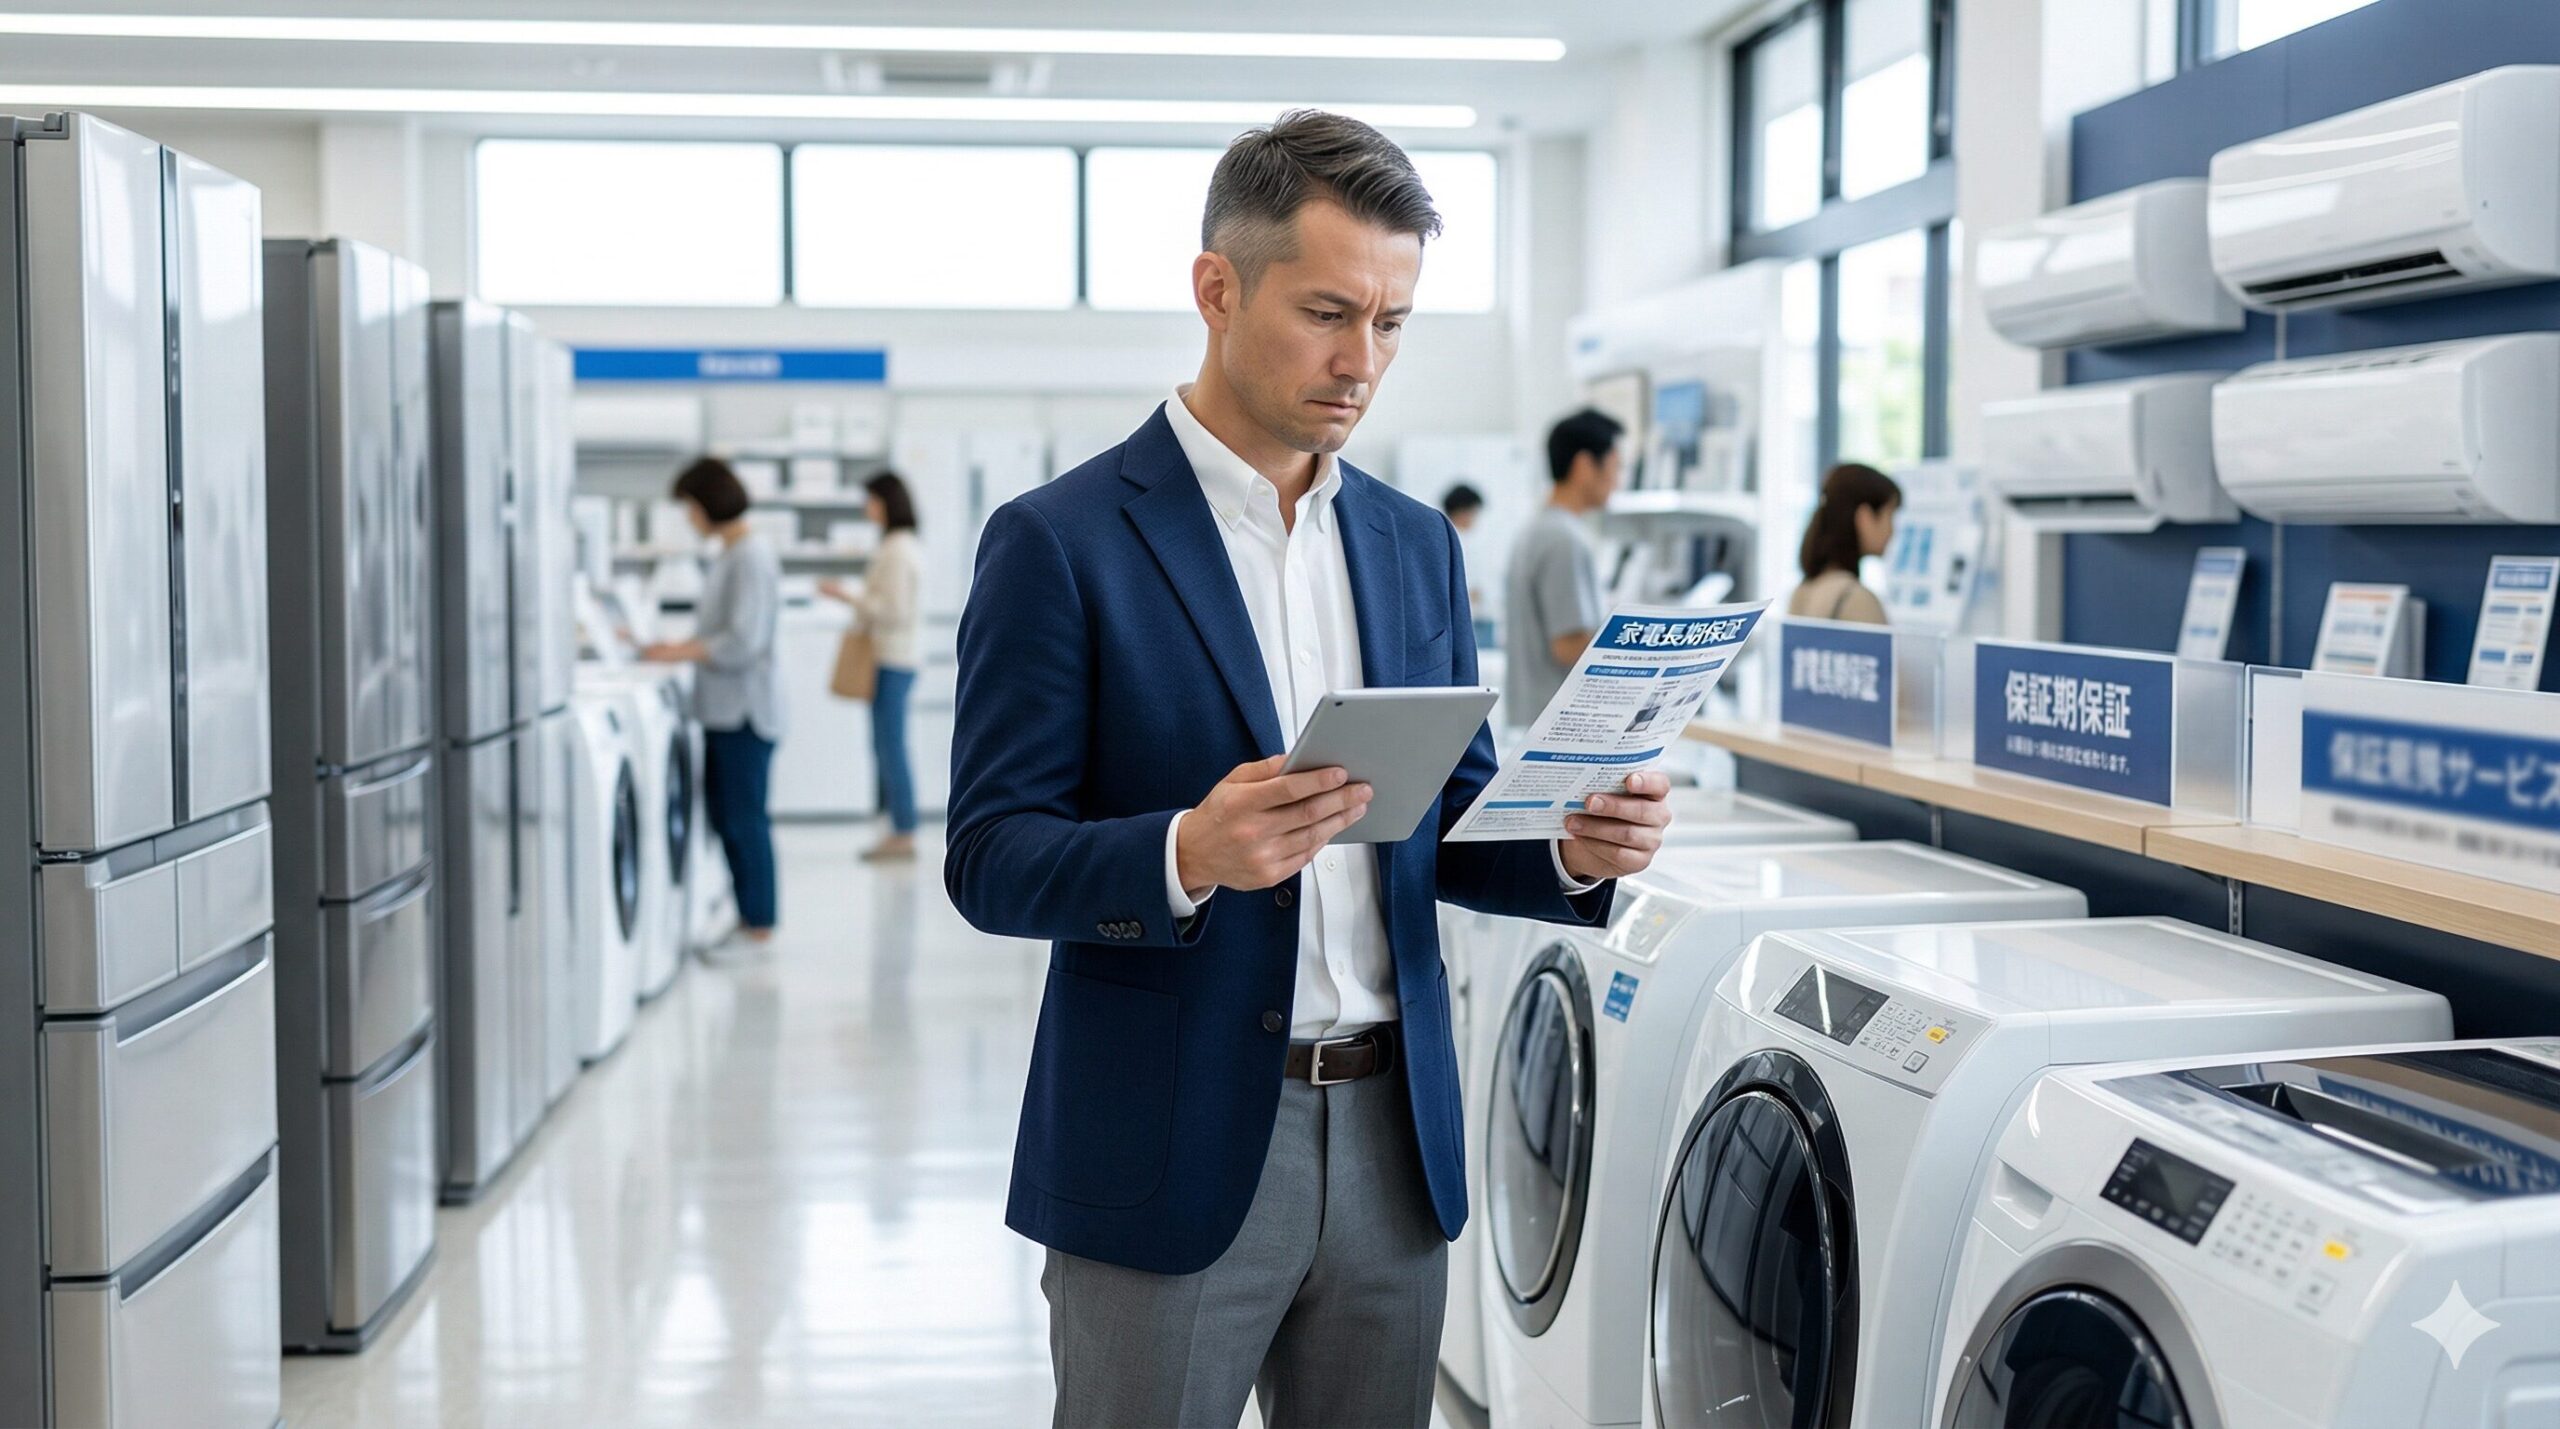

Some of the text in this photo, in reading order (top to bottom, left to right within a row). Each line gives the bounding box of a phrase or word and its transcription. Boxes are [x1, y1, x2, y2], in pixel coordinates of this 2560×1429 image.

[2005, 669, 2131, 739] 保証期保証
